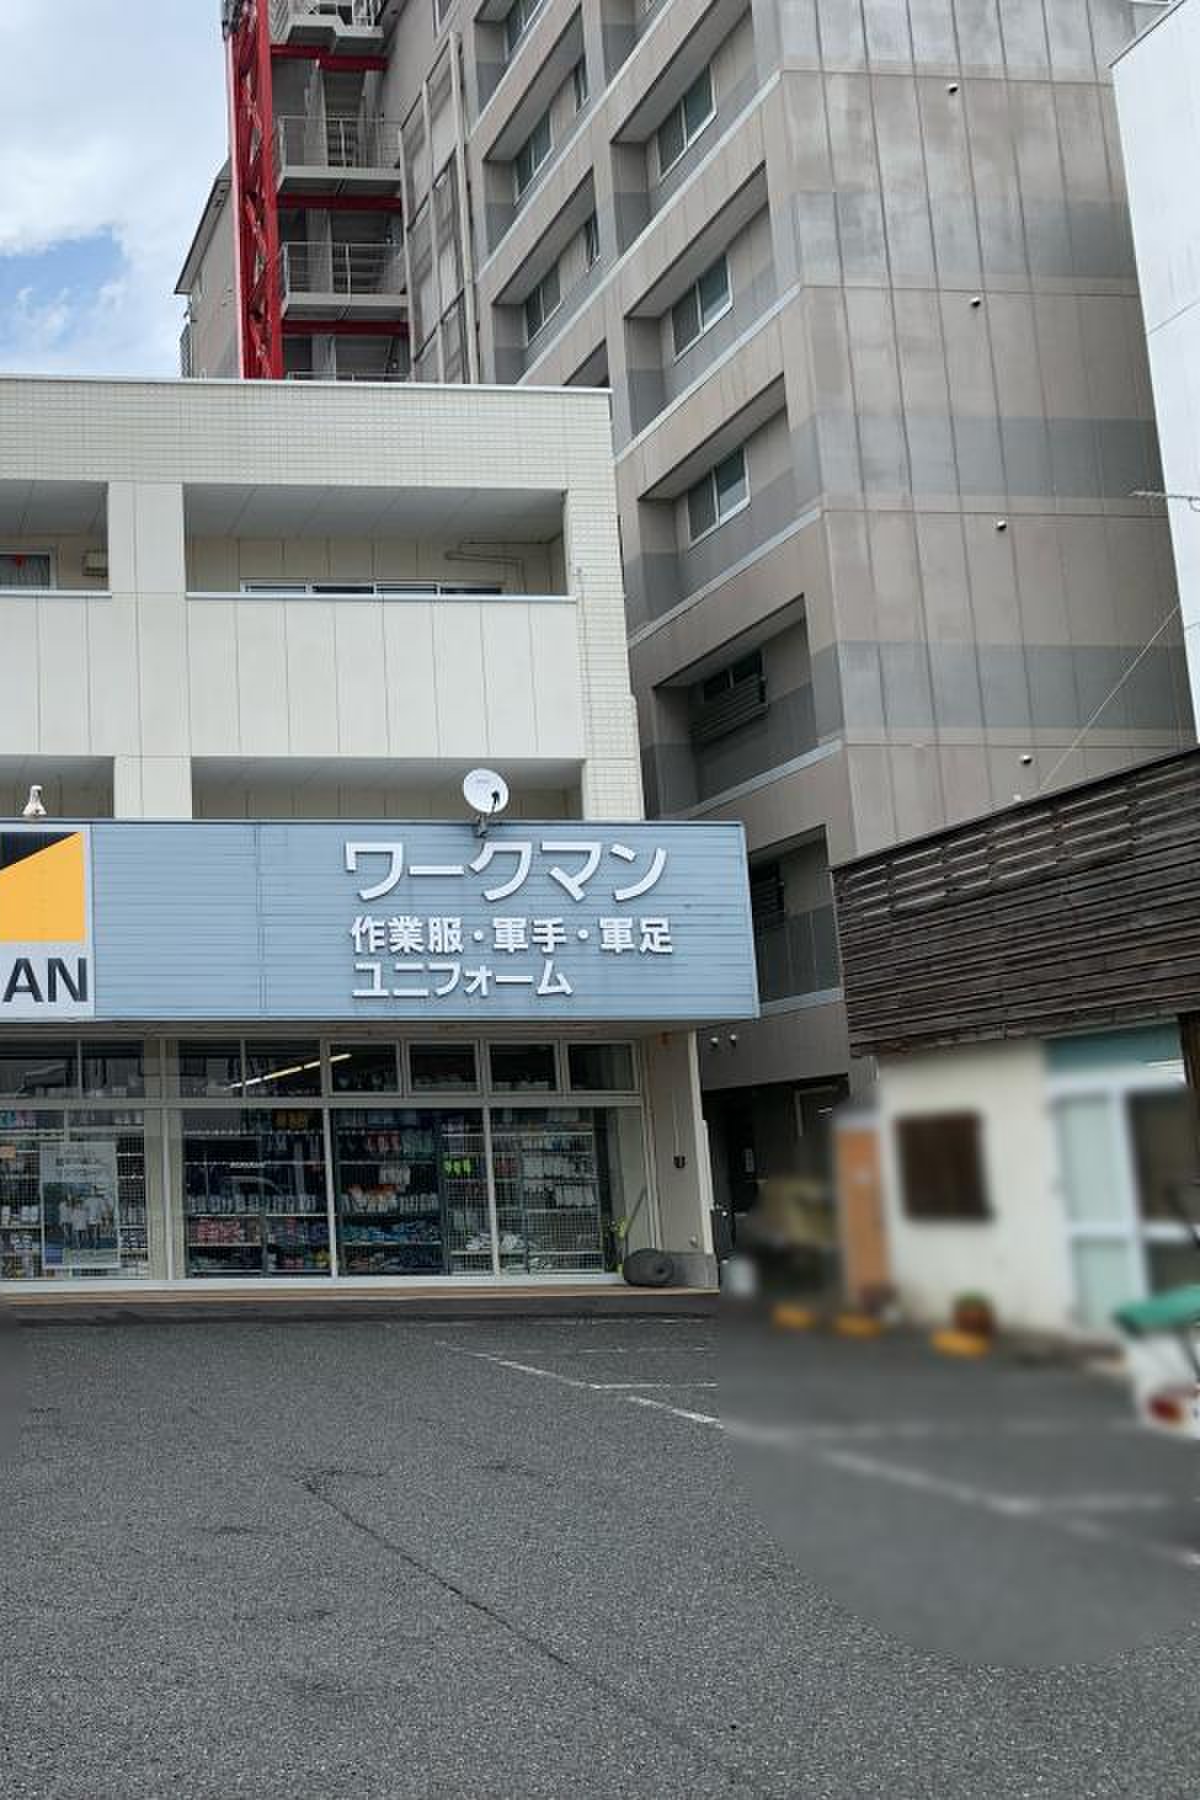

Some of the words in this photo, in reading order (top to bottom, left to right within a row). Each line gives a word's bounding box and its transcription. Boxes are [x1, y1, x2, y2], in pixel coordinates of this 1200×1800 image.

[345, 841, 667, 901] ワークマン
[351, 915, 673, 953] 作業服・軍手・軍足
[351, 959, 574, 998] ユニフォーム
